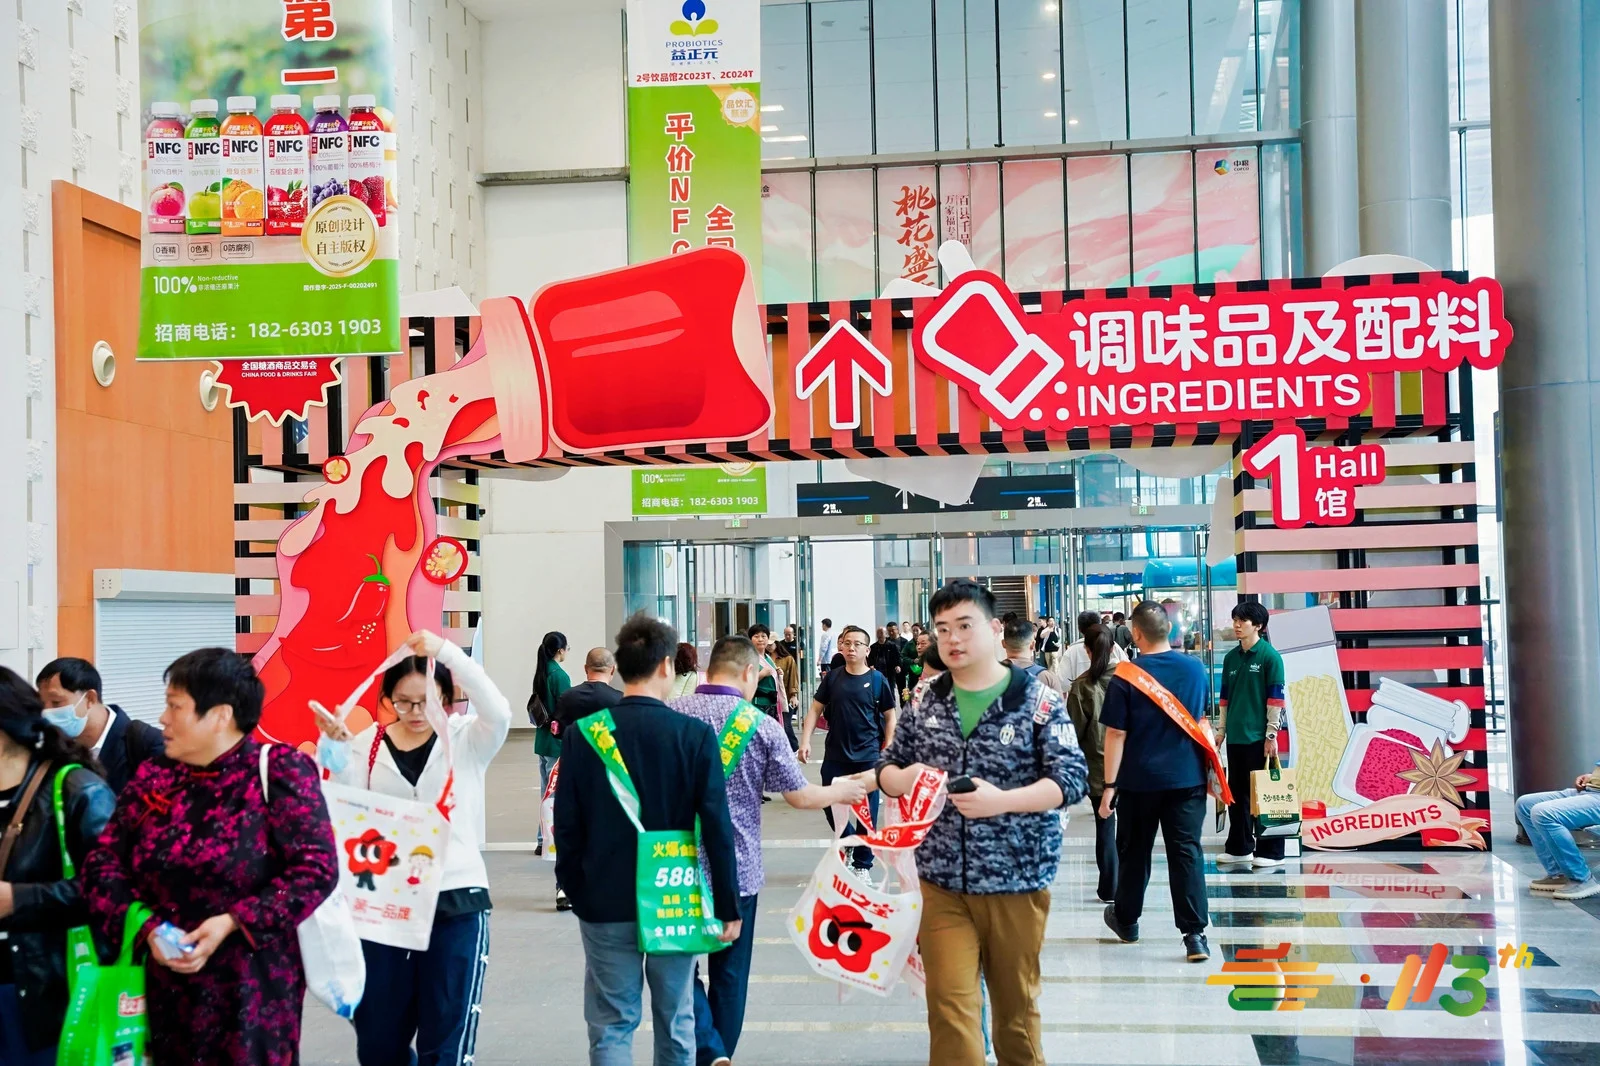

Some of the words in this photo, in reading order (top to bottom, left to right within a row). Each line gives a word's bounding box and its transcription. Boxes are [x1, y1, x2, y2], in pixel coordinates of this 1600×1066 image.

[282, 0, 337, 84] 第一
[665, 39, 724, 48] PROBIOTICS
[671, 48, 719, 61] 益正元
[155, 142, 182, 155] NFC
[231, 140, 259, 153] NFC
[276, 139, 303, 153] NFC
[319, 136, 344, 149] NFC
[353, 135, 380, 148] NFC
[194, 143, 221, 155] NFC
[314, 217, 365, 234] 原创设计
[891, 184, 938, 286] 桃花盛
[316, 239, 366, 256] 自主版权
[153, 275, 198, 294] 100%
[248, 321, 333, 338] 182-6303
[338, 318, 382, 335] 1903
[1069, 289, 1499, 376] 调味品及配料
[241, 360, 318, 371] 全国糖酒商品交易会
[1077, 372, 1362, 418] INGREDIENTS
[1250, 432, 1300, 521] 1
[1315, 451, 1378, 479] Hall
[689, 497, 734, 506] 182-6303
[736, 496, 759, 505] 1903
[1027, 496, 1035, 507] 2
[1314, 486, 1348, 519] 馆
[822, 503, 831, 514] 2
[1310, 804, 1443, 842] INGREDIENTS
